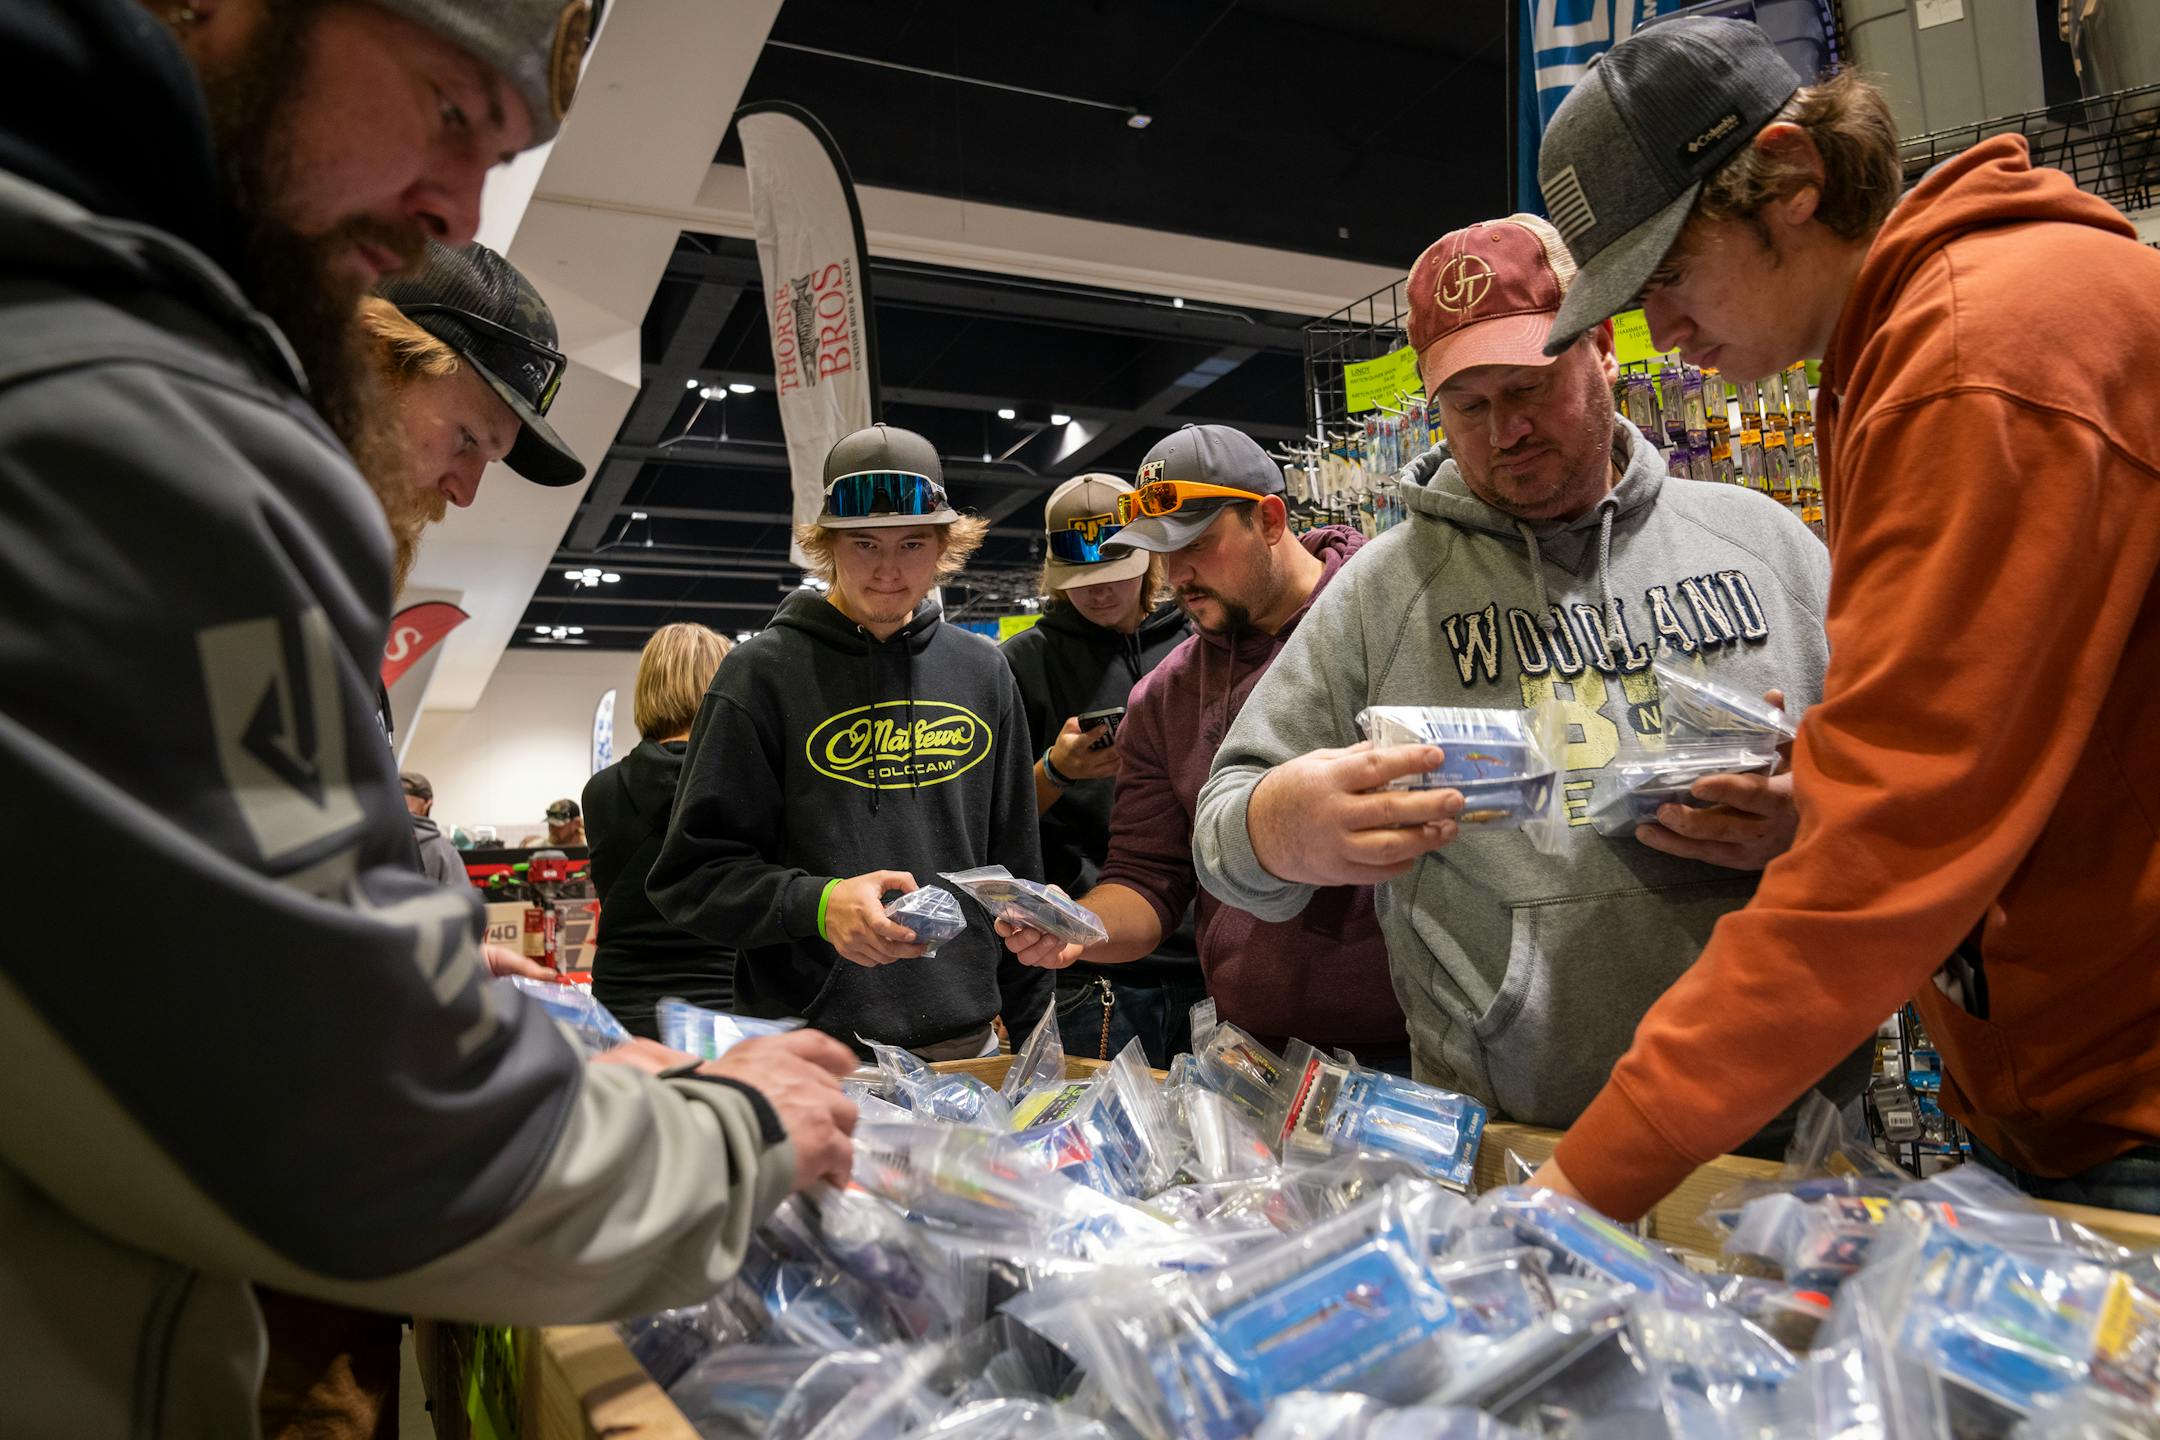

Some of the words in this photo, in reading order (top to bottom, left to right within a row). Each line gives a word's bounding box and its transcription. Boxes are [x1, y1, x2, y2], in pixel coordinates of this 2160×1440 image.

[776, 284, 800, 396] THORNE
[811, 263, 851, 380] BROS
[826, 716, 976, 766] Mathews
